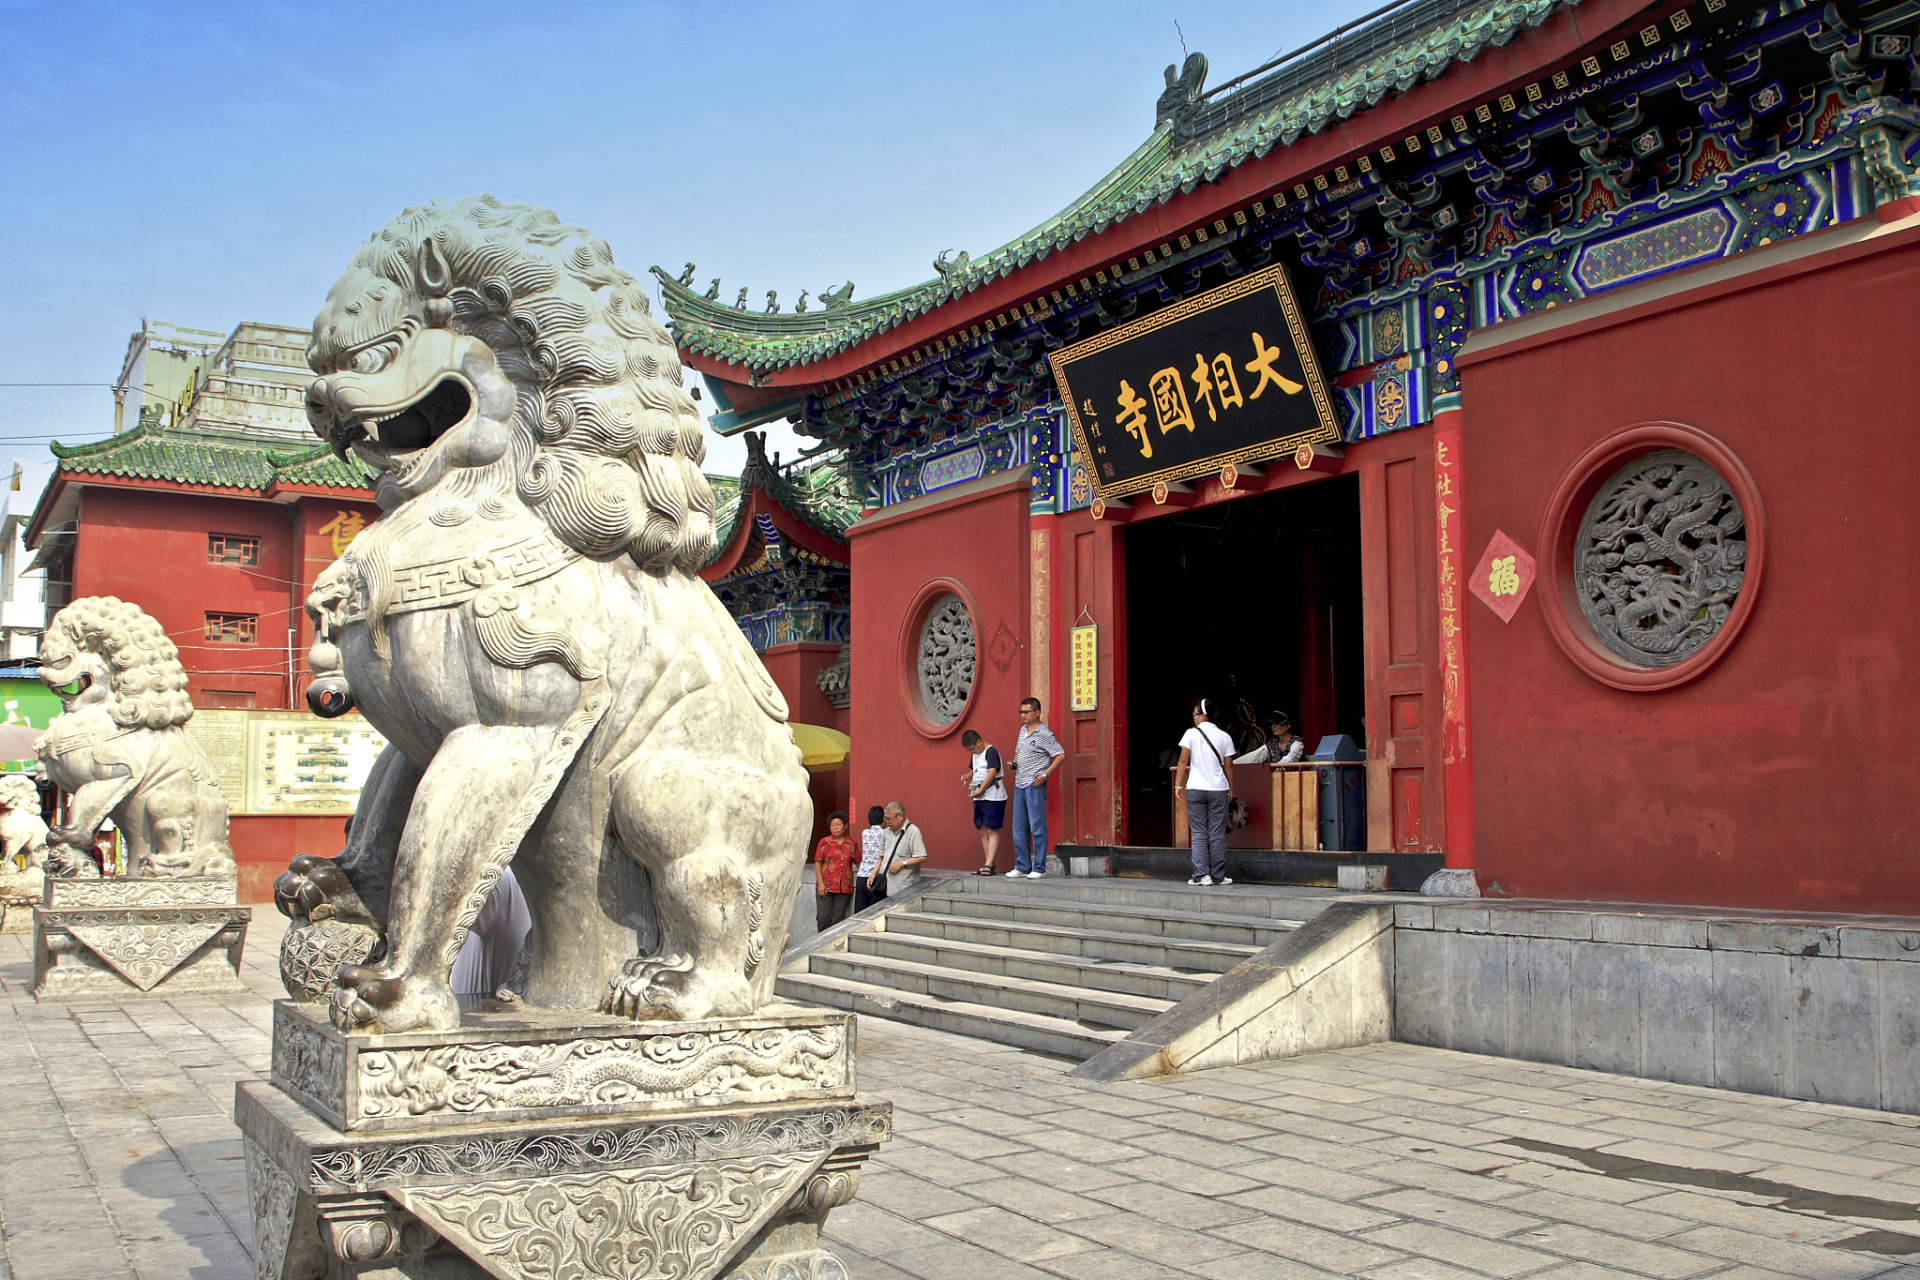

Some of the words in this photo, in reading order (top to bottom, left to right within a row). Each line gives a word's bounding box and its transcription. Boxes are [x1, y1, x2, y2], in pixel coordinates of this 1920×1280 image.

[1115, 331, 1304, 458] 大相國寺
[1489, 555, 1519, 596] 福
